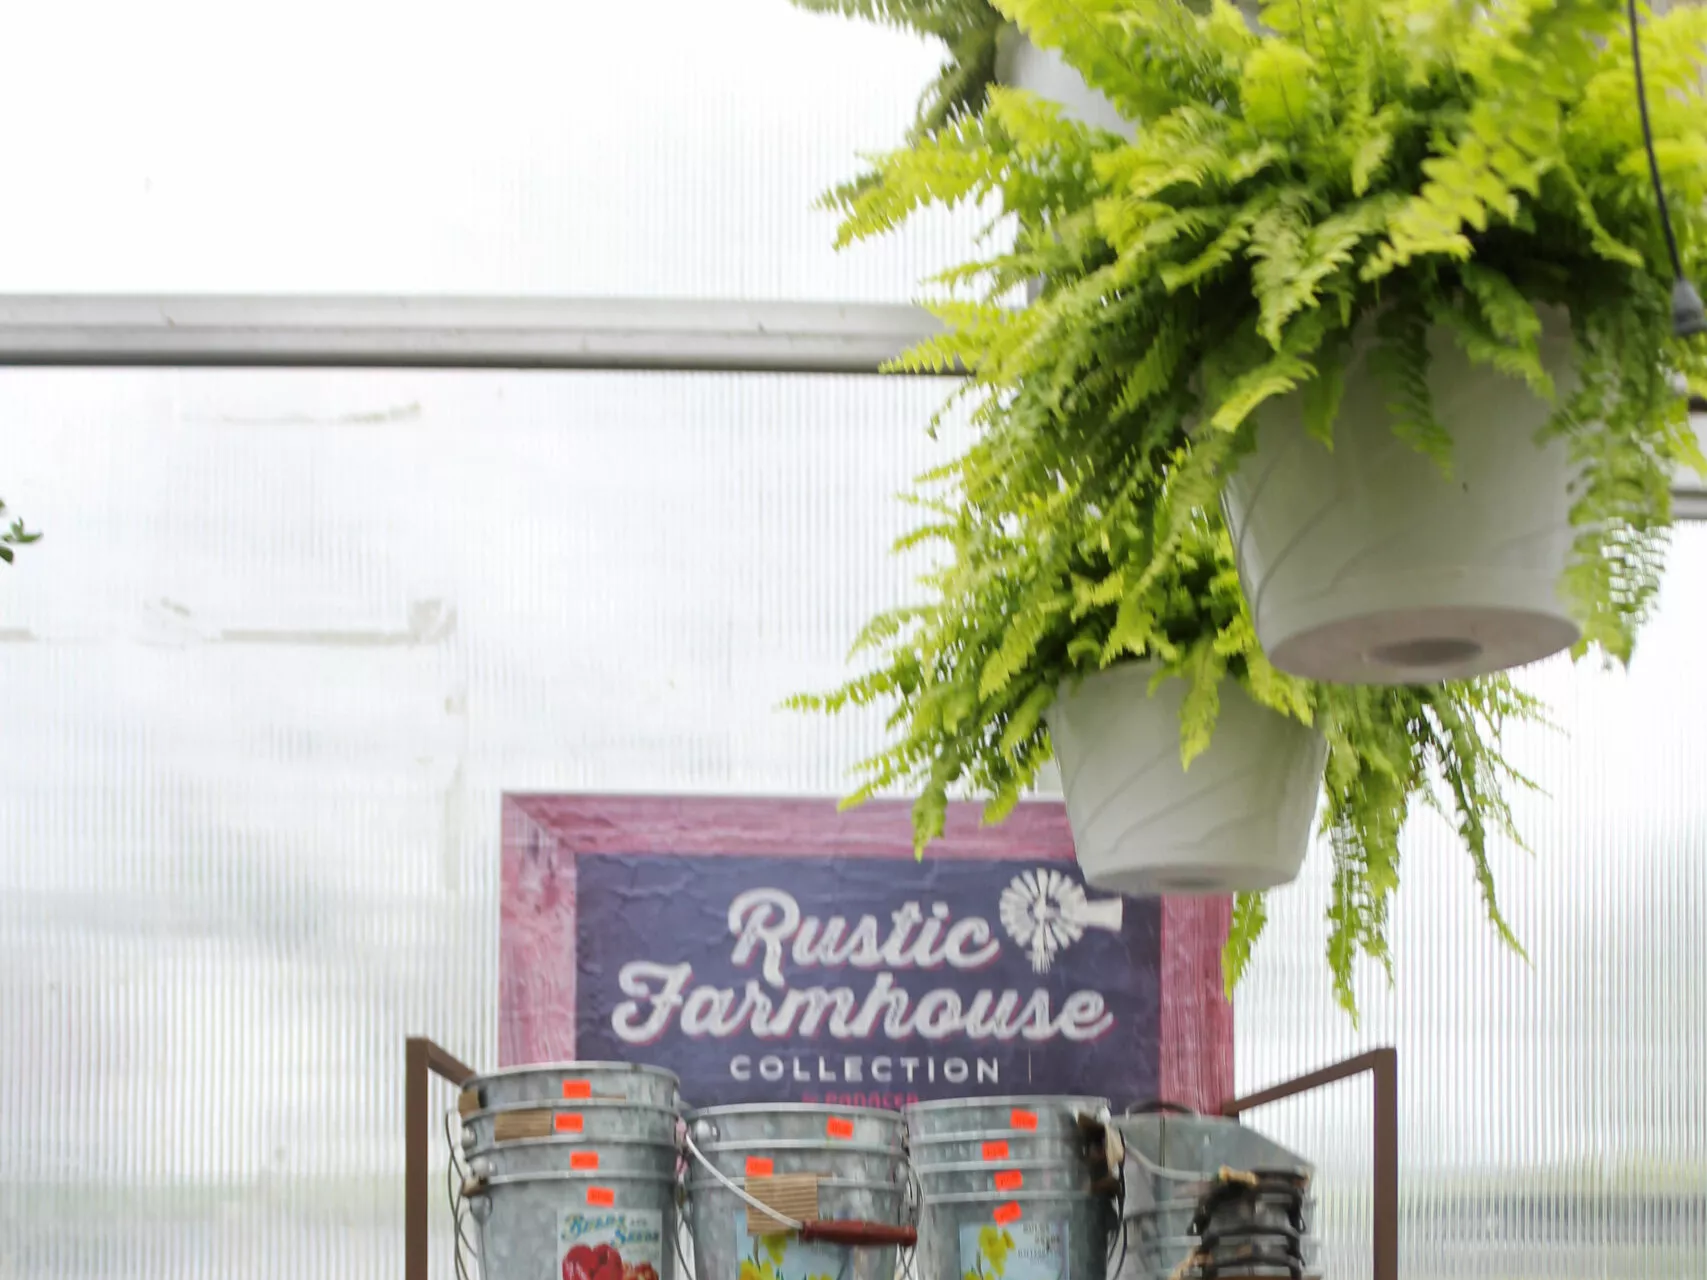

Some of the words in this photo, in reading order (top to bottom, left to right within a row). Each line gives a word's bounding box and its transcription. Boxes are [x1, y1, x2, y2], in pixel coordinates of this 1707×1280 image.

[728, 887, 1001, 989] Rustic
[611, 960, 1117, 1045] Farmhouse
[730, 1054, 999, 1084] COLLECTION
